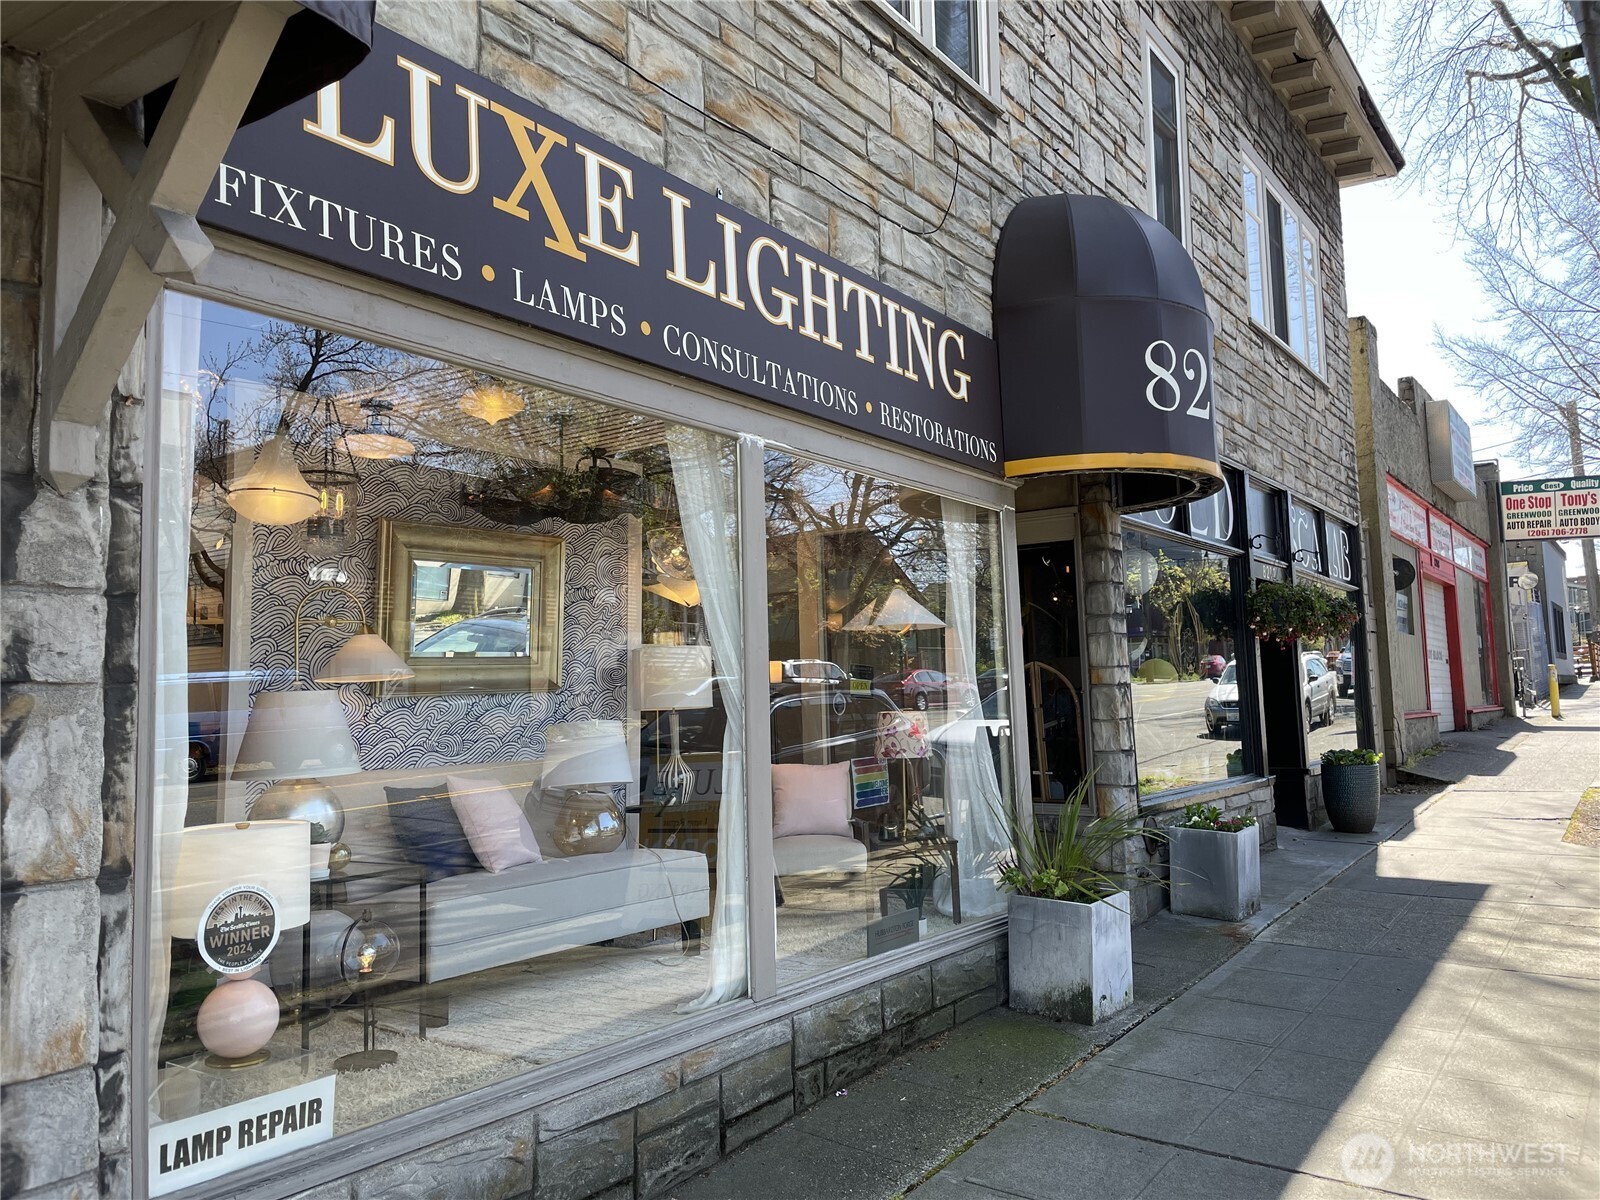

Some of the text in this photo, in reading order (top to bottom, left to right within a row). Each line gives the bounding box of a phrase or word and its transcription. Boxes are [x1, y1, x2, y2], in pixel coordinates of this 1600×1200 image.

[303, 55, 971, 403] LUXE LIGHTING
[214, 163, 997, 463] FIXTURES LAMPS CONSULTATIONS RESTORATIONS
[1145, 340, 1210, 419] 82
[1513, 484, 1534, 492] Price
[1570, 479, 1599, 488] Quality
[1506, 496, 1552, 510] One Stop
[1560, 492, 1597, 506] Tony's
[1507, 510, 1552, 520] GREENWOOD
[1558, 507, 1600, 516] GREENWOO
[1507, 520, 1552, 530] AUTO REPAIR
[1560, 517, 1600, 527] AUTO BODY
[853, 681, 868, 690] OPEN
[212, 903, 228, 920] BEST
[254, 896, 269, 911] PNW
[209, 925, 270, 949] WINNER
[227, 942, 253, 957] 2024
[160, 1096, 323, 1175] LAMP REPAIR
